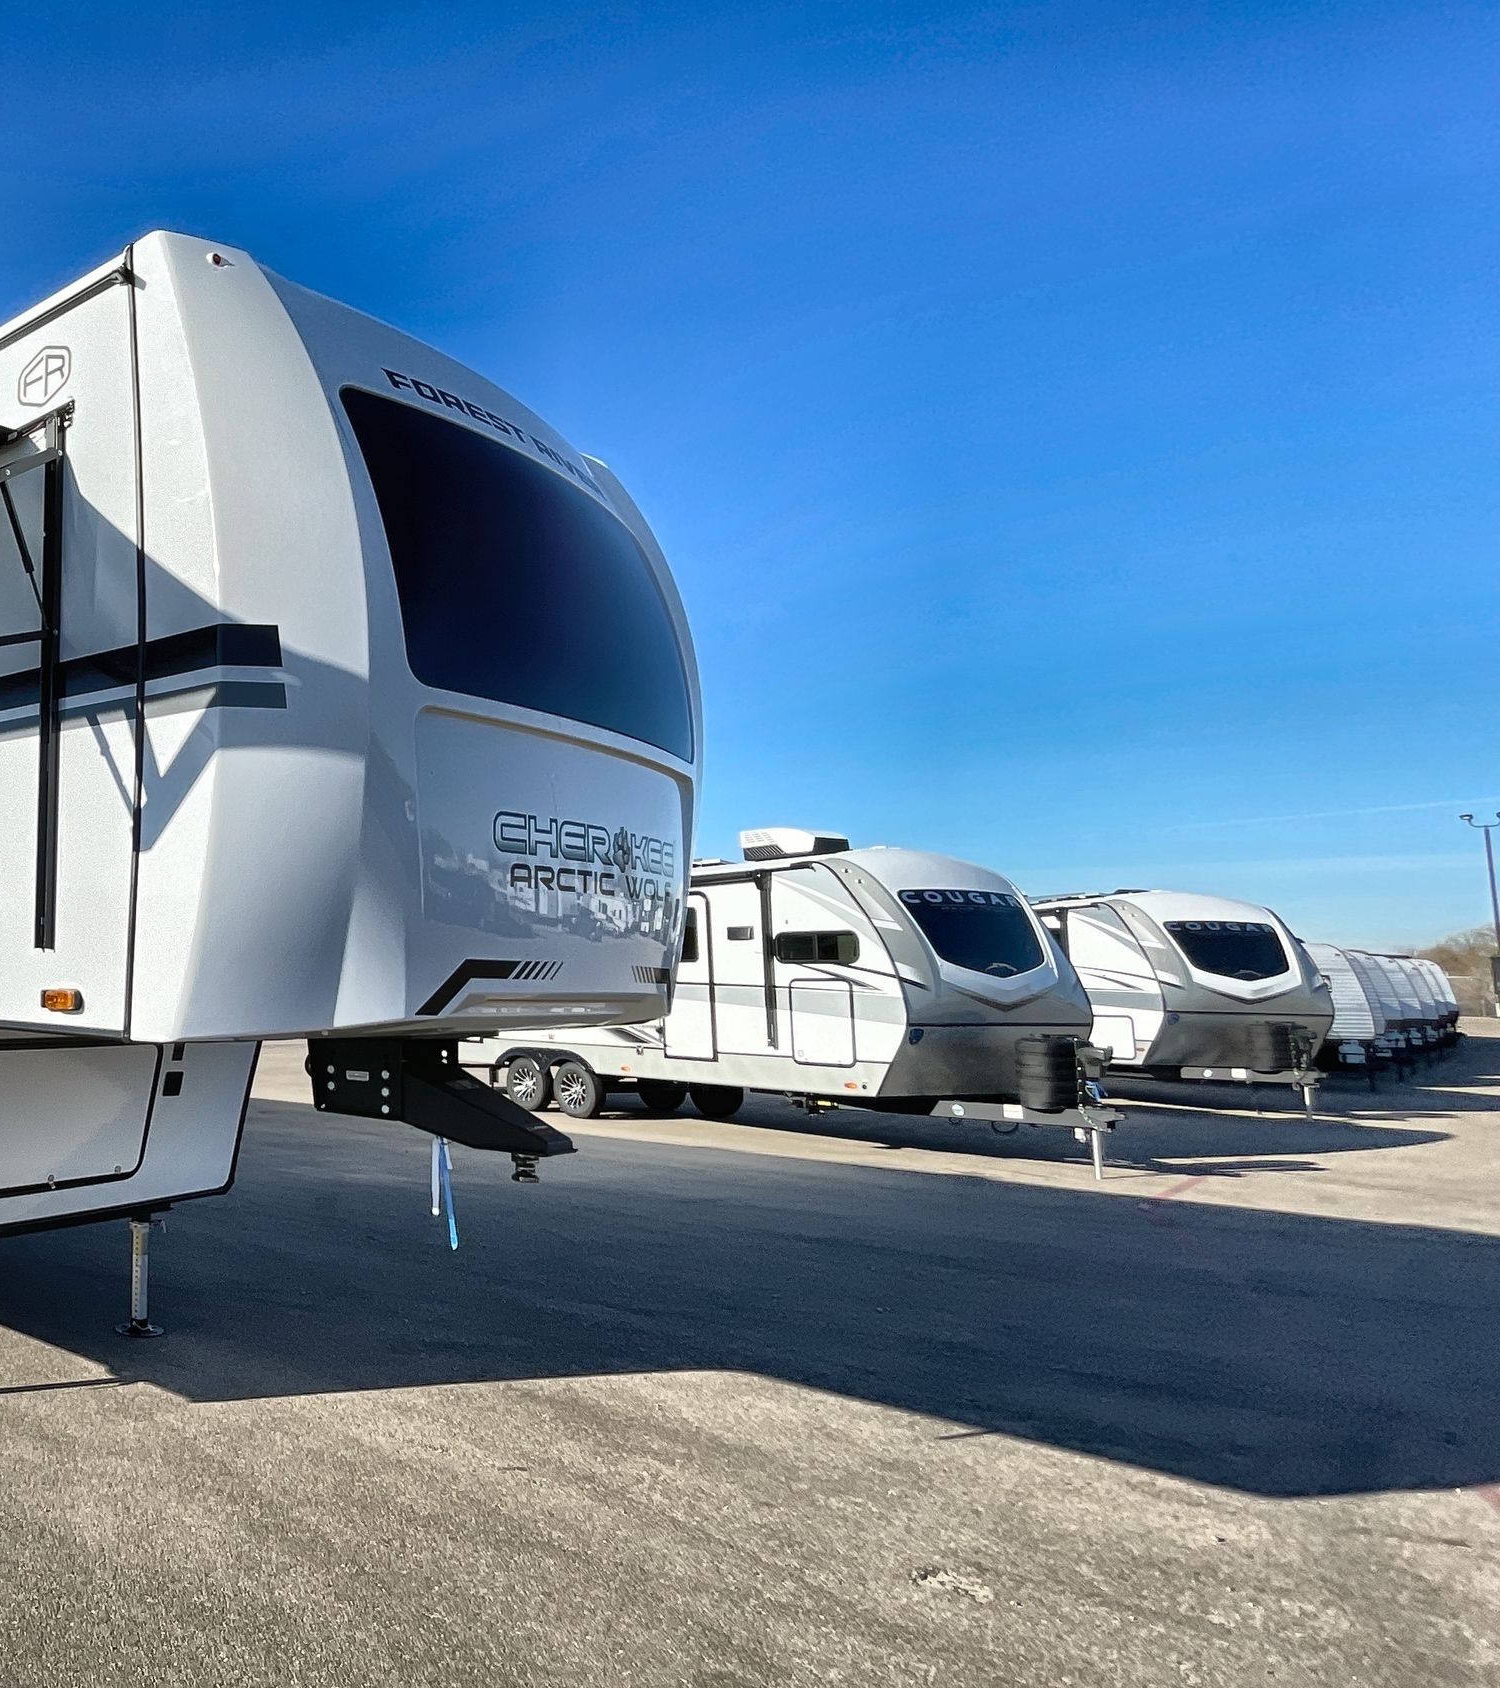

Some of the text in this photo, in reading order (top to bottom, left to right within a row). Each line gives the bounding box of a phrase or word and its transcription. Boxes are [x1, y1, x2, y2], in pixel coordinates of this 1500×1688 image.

[380, 367, 526, 443] FOREST
[510, 863, 671, 902] ARCTIC WOLF
[901, 891, 1022, 908] COUGAR
[1165, 922, 1274, 933] COUGAR
